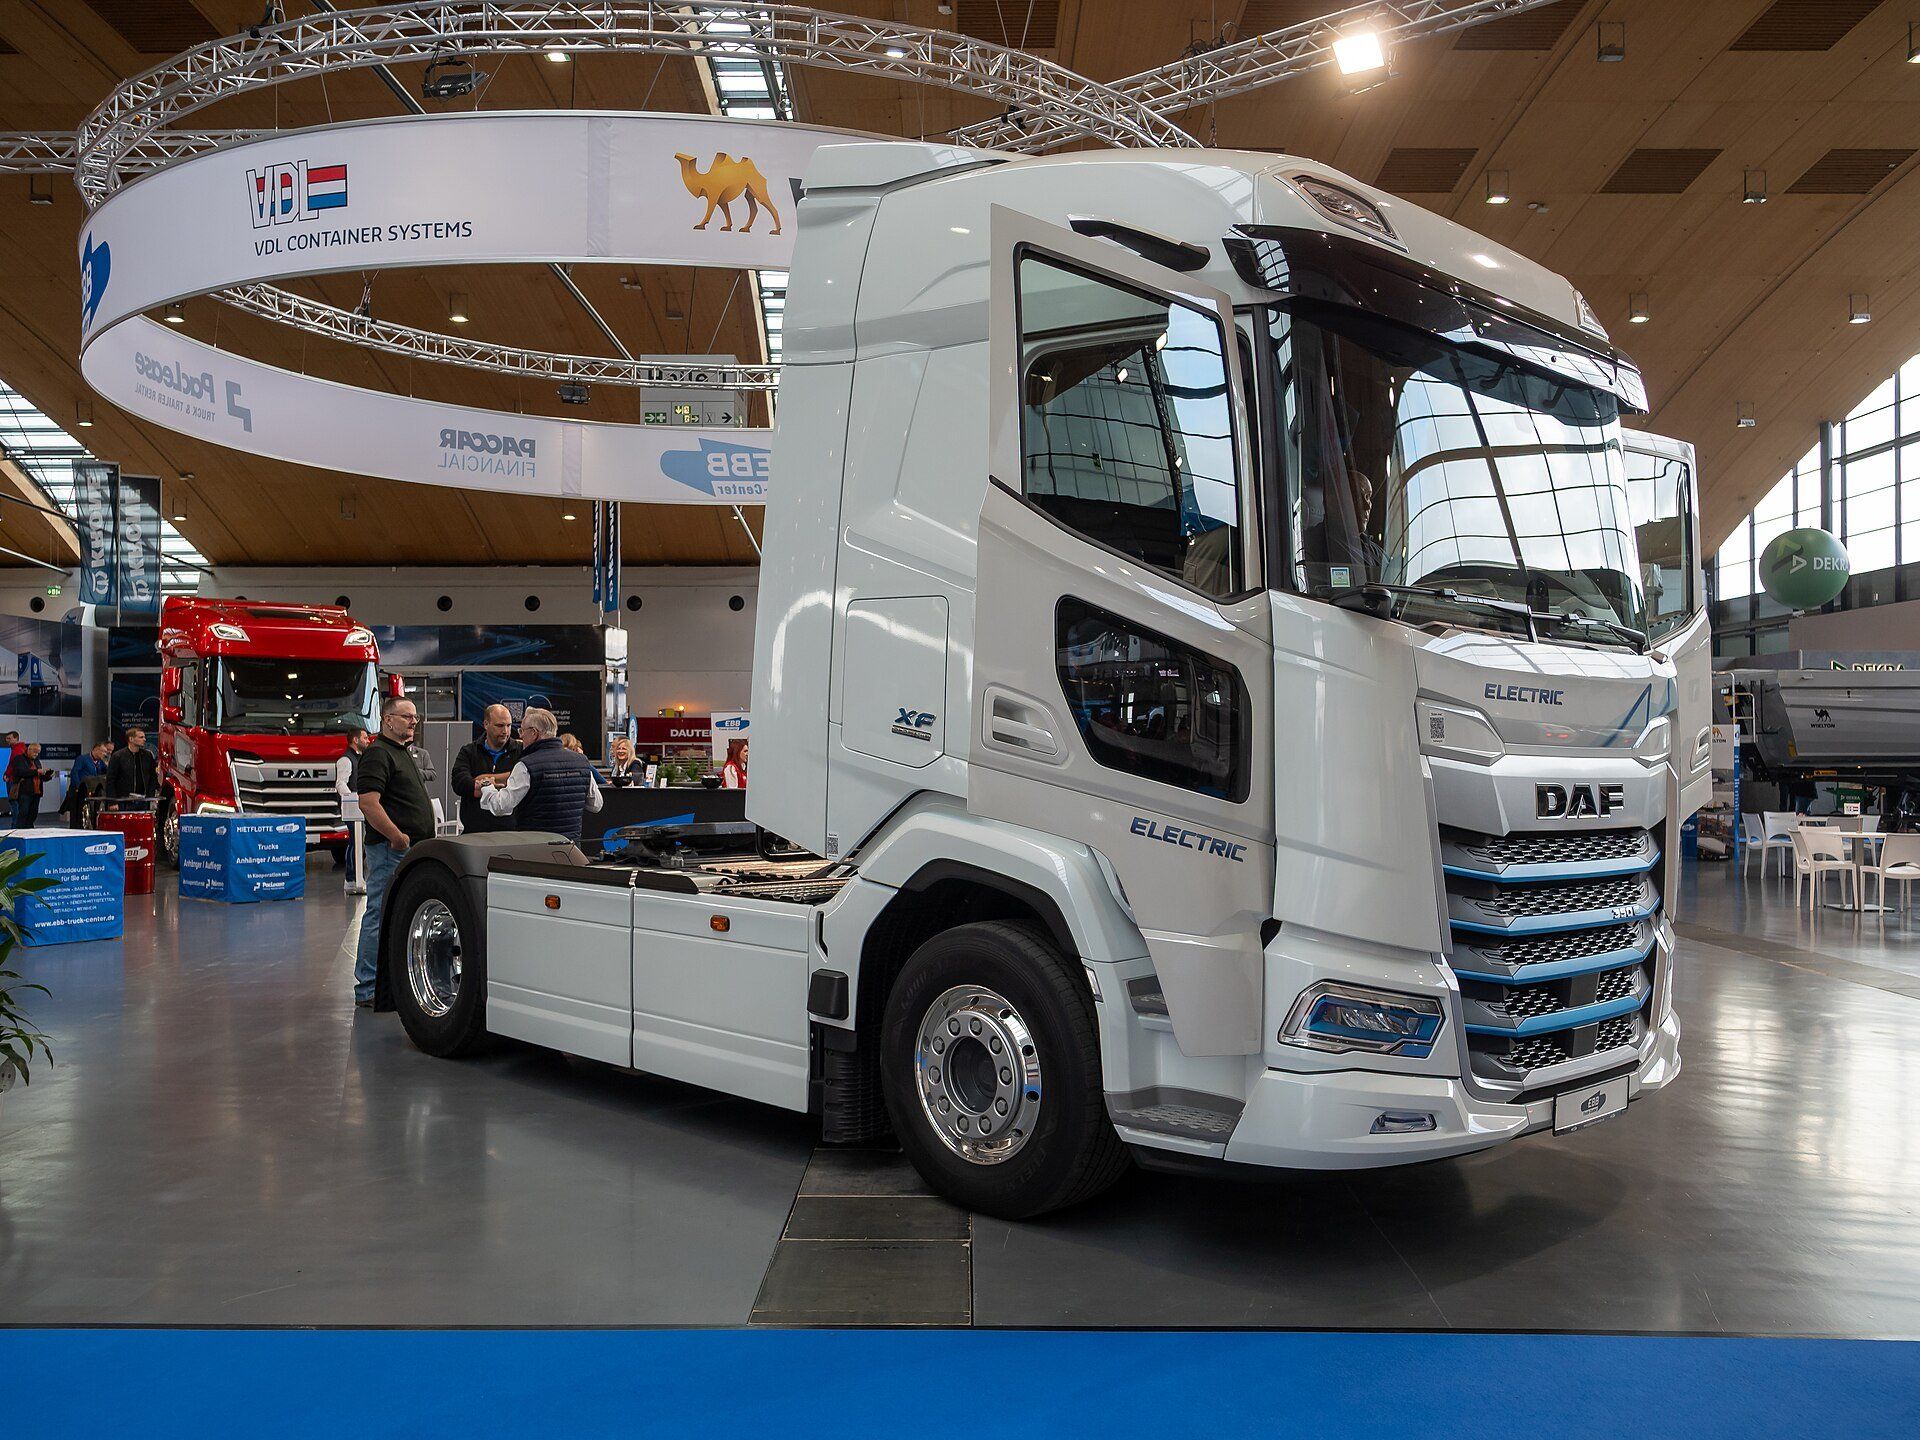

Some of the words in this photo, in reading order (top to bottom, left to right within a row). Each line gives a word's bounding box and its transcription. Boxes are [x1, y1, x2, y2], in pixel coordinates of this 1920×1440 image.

[246, 159, 319, 229] VDL
[254, 238, 283, 257] VDL
[287, 226, 382, 251] CONTAINER
[388, 221, 473, 241] SYSTEMS
[1484, 683, 1564, 706] ELECTRIC
[894, 707, 937, 728] XF
[278, 769, 328, 779] DAF
[1535, 782, 1625, 820] DAF
[236, 825, 274, 833] MIETFLOTTE
[1130, 816, 1247, 862] ELECTRIC
[236, 857, 266, 865] Anhänger
[271, 855, 301, 863] Auflieger
[59, 865, 105, 874] Süddeutschland
[34, 914, 115, 928] www.ebb-truck-center.de
[1587, 1096, 1600, 1109] EBB
